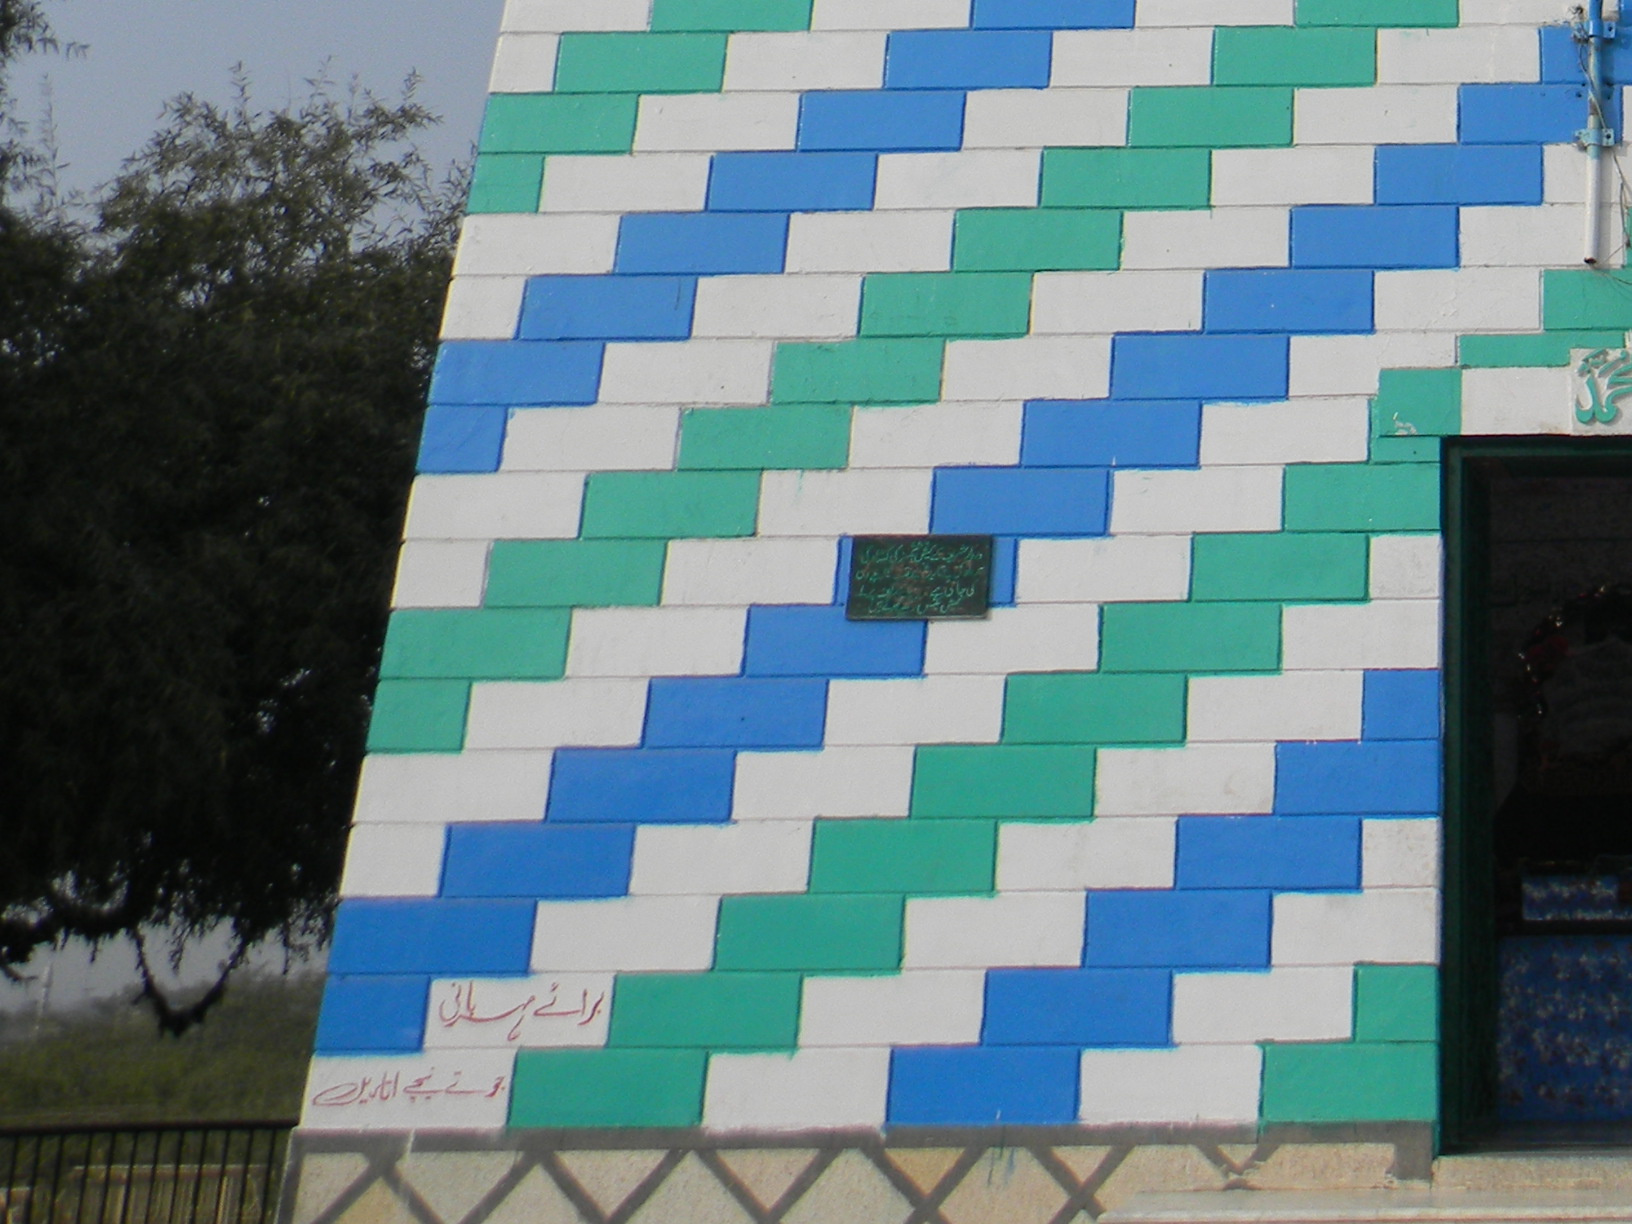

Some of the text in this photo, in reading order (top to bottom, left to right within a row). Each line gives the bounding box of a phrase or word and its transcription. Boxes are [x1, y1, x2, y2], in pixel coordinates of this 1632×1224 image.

[439, 980, 605, 1042] برائے مہربانی
[312, 1067, 506, 1107] جوتے نیچے اتاریں
